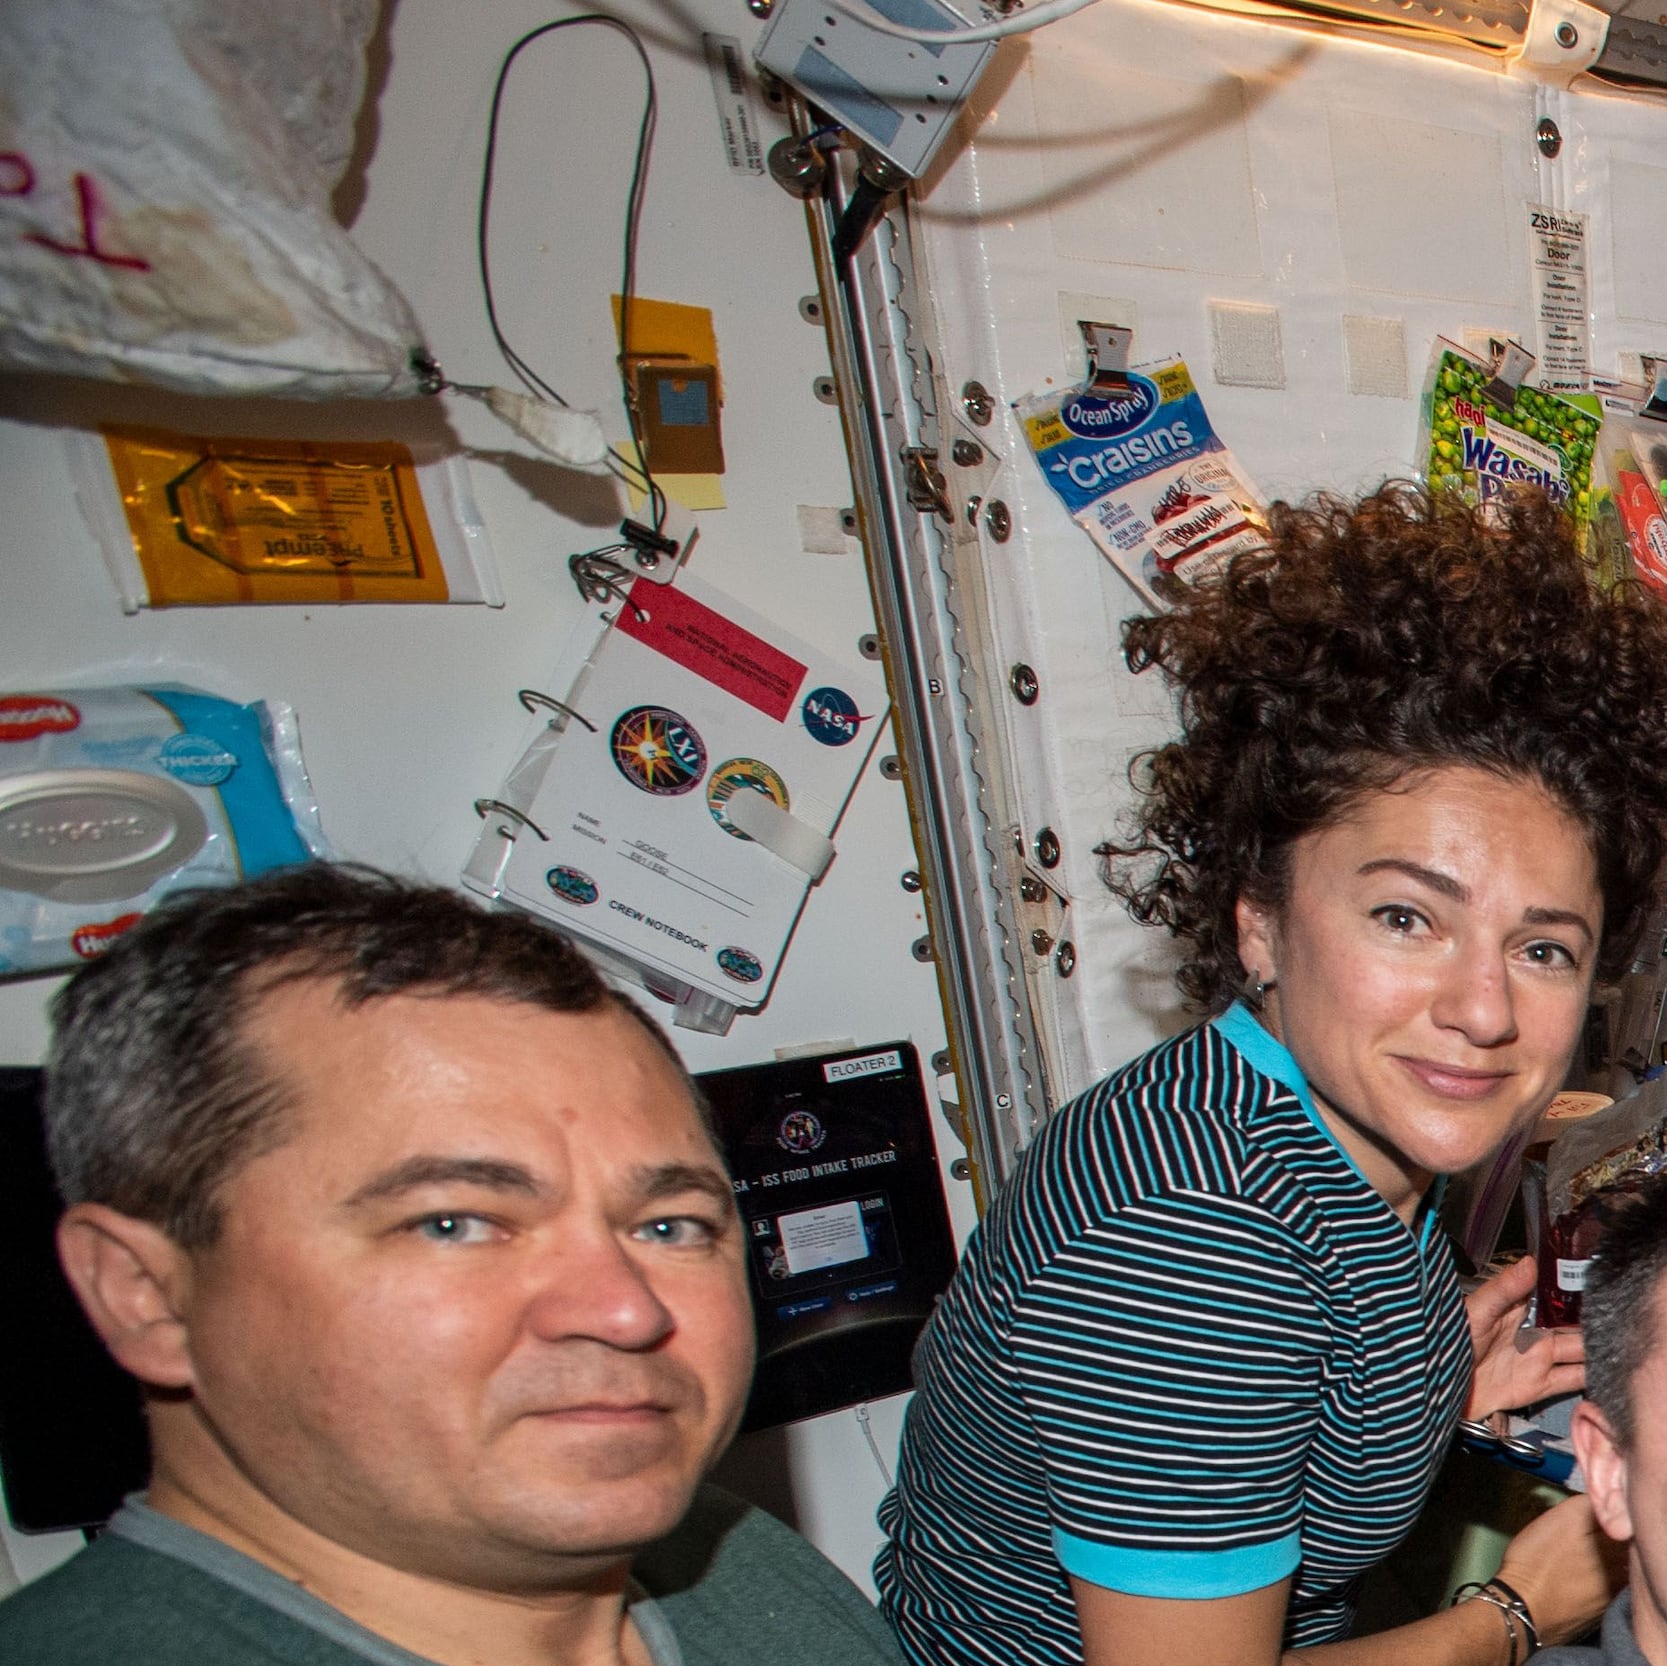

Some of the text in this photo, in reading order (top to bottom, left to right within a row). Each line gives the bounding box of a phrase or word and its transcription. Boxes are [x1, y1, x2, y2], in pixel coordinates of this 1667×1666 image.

[1547, 247, 1571, 261] Door
[1069, 386, 1150, 426] Ocean Spray
[1067, 421, 1195, 489] Craisins
[929, 679, 940, 693] B
[806, 698, 856, 736] NASA
[666, 725, 699, 766] LXI
[570, 822, 608, 845] MISSION
[608, 899, 710, 953] CREW NOTEBOOK
[830, 1055, 897, 1078] FLOATER 2
[997, 1094, 1009, 1107] C
[762, 1150, 897, 1188] ISS FOOD INTAKE TRACKER
[860, 1198, 884, 1212] LOGIN
